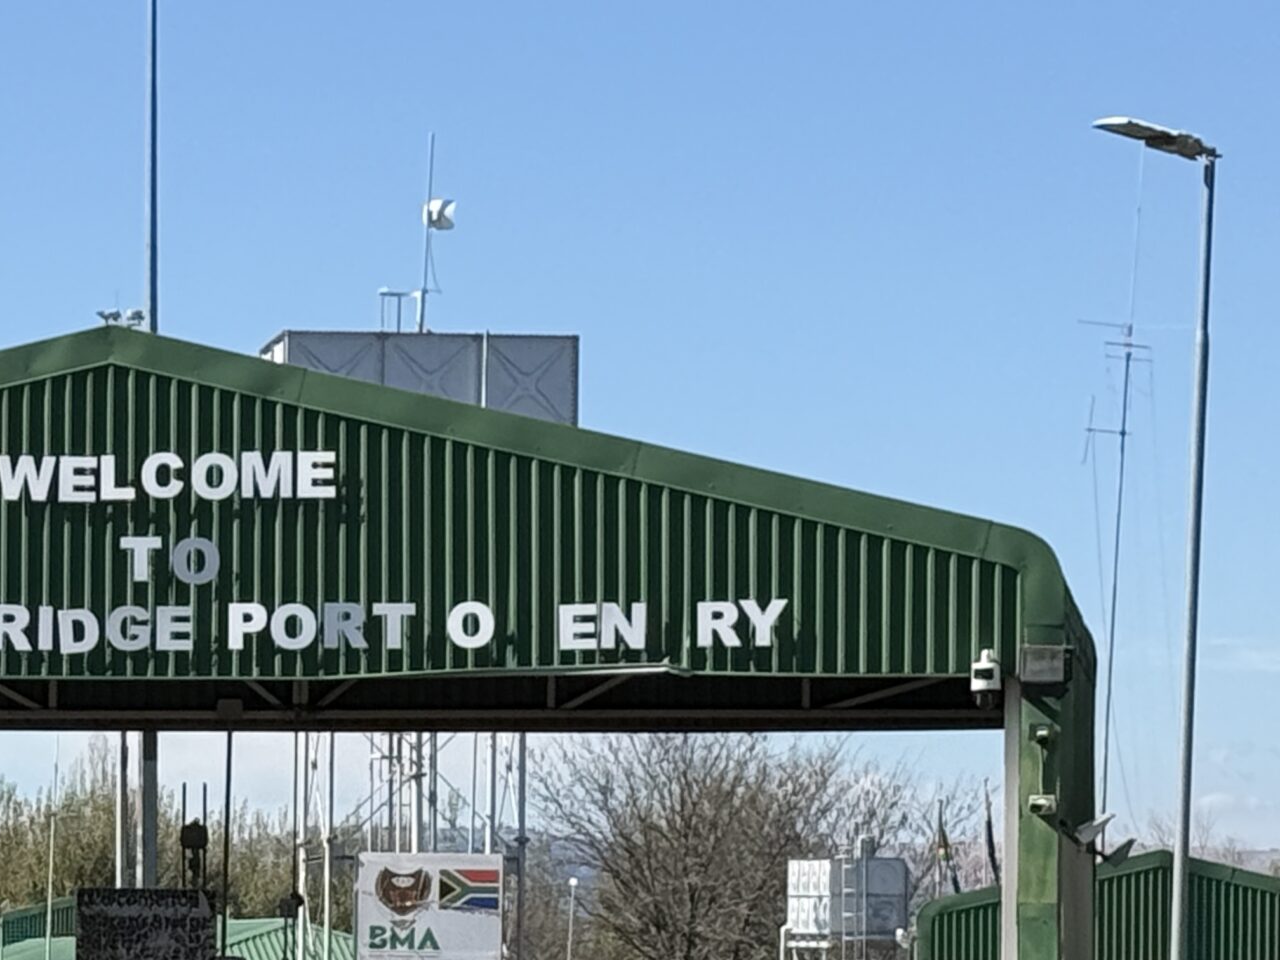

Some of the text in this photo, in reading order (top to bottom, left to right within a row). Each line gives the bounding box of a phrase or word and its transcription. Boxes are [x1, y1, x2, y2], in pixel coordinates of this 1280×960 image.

[120, 536, 220, 585] TO
[227, 602, 416, 650] PORT
[368, 925, 441, 950] BMA
